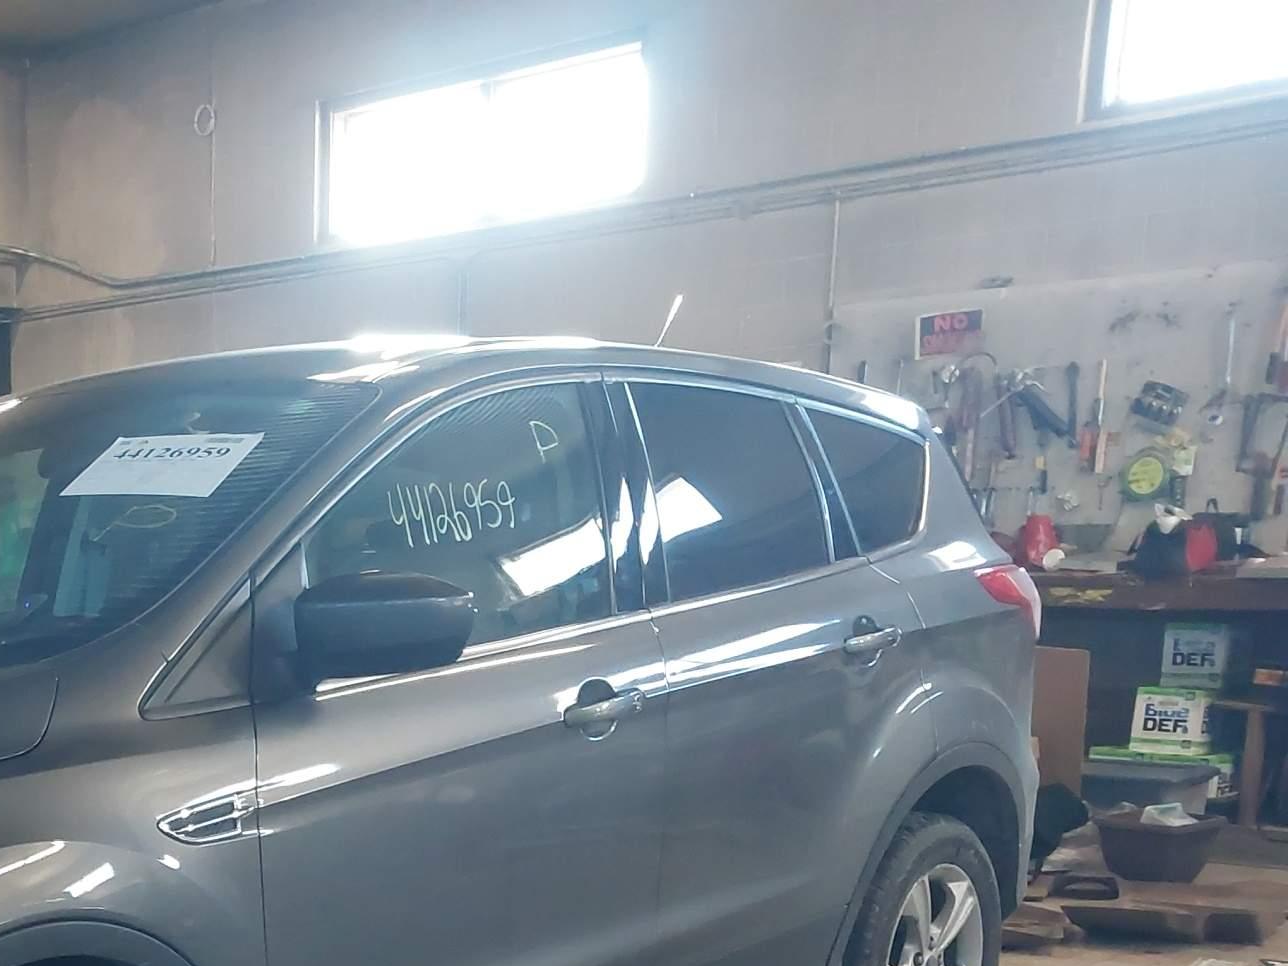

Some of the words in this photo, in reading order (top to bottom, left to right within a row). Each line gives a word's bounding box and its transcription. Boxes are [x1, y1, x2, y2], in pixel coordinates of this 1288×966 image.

[934, 314, 969, 332] NO
[113, 446, 231, 459] 44126959
[386, 478, 516, 548] 44126959
